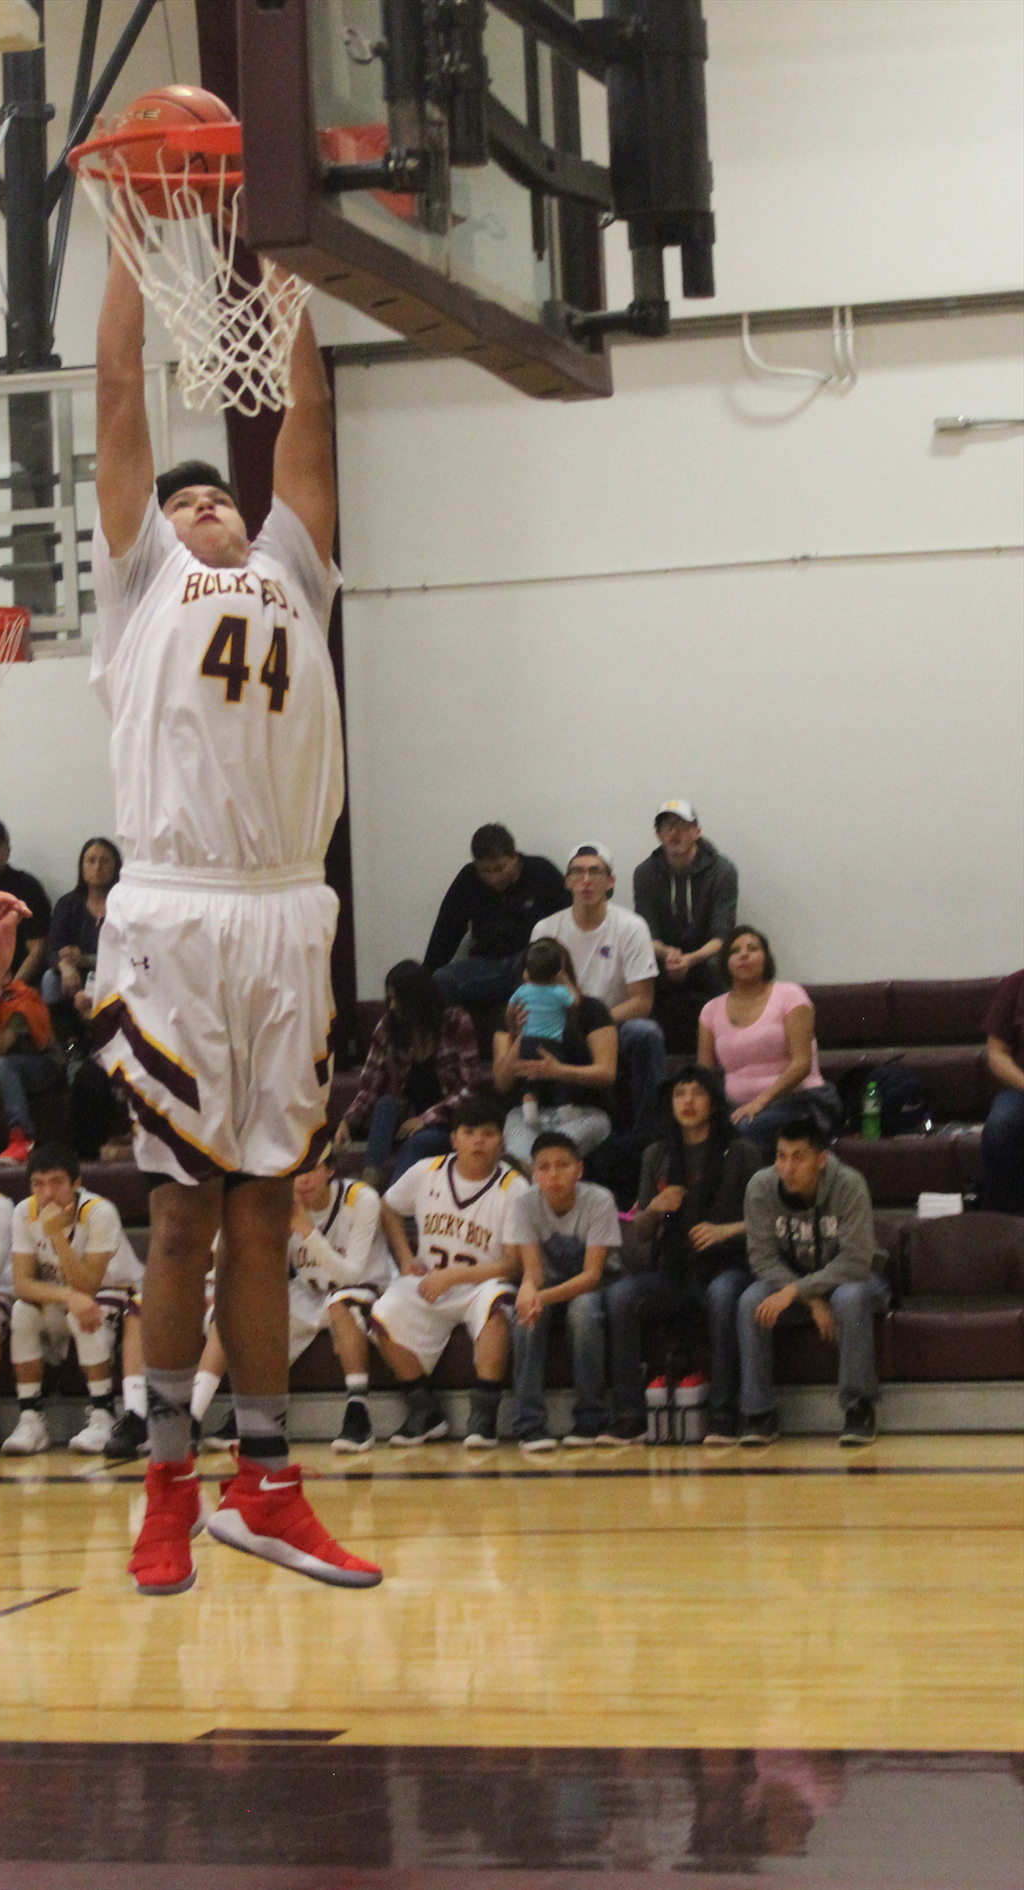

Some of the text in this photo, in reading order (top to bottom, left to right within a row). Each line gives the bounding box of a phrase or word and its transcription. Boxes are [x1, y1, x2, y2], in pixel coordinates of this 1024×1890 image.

[198, 614, 290, 715] 44
[422, 1212, 493, 1252] ROCKY BOY
